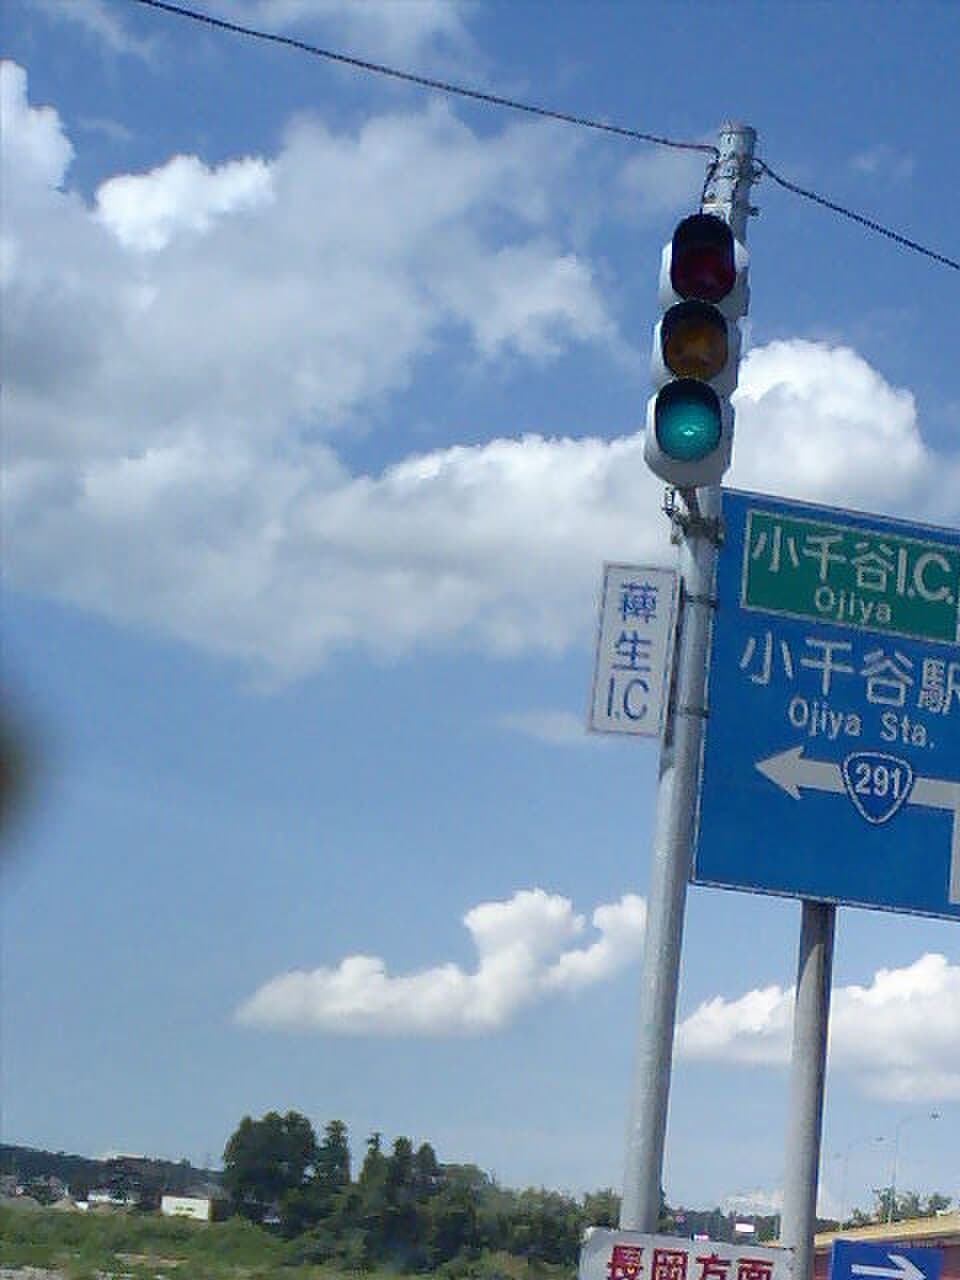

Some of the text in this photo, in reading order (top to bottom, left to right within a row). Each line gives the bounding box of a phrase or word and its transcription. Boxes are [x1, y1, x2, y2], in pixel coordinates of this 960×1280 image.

[815, 586, 891, 625] Ojiya
[788, 697, 936, 749] Ojiya Sta.
[855, 762, 902, 800] 291
